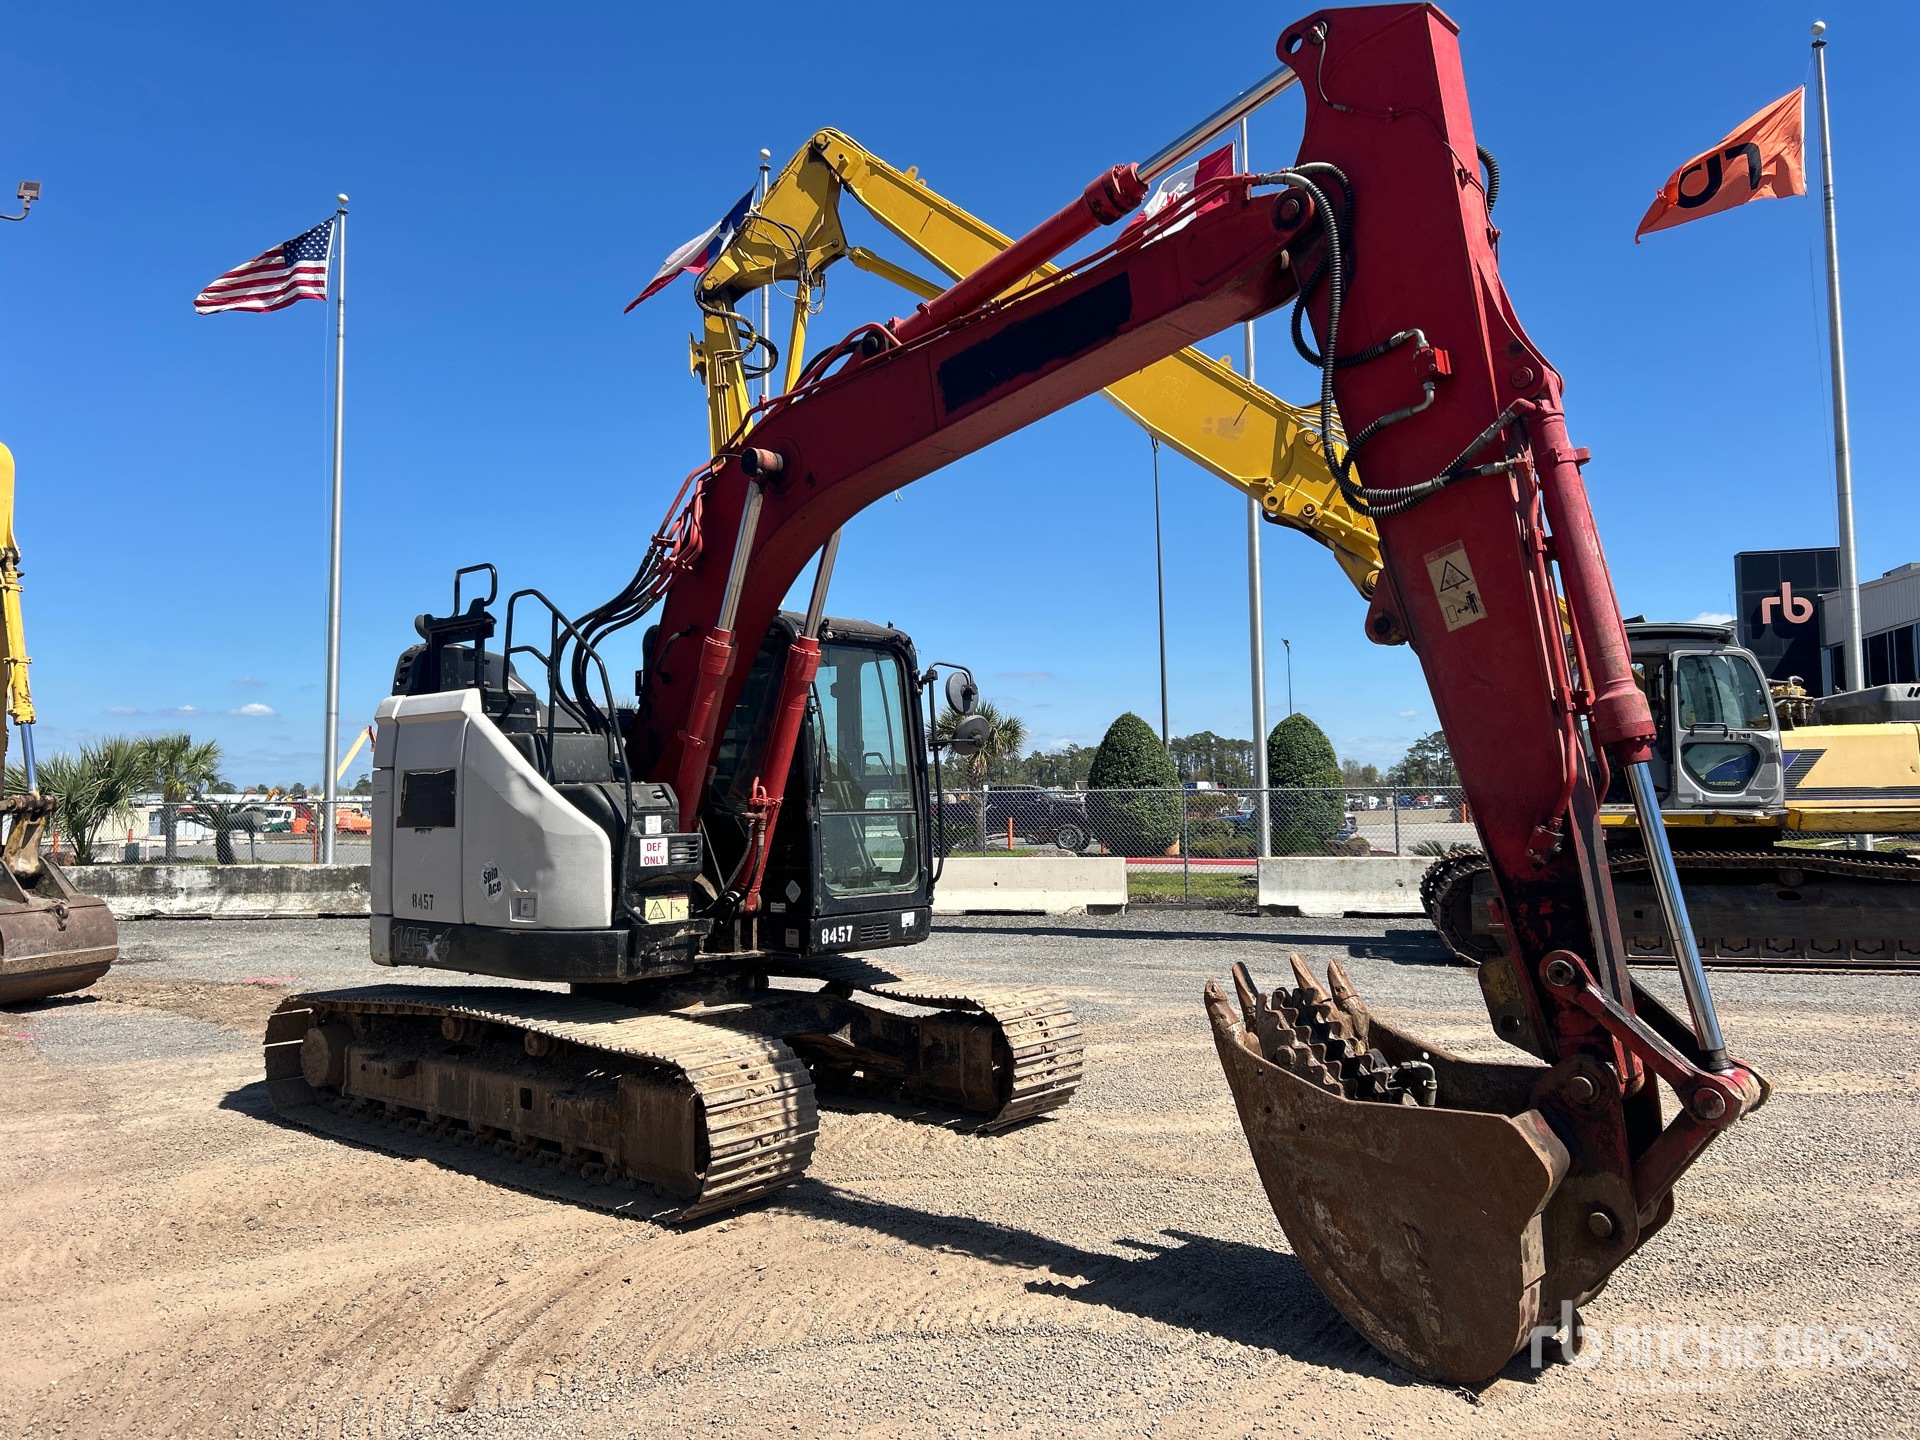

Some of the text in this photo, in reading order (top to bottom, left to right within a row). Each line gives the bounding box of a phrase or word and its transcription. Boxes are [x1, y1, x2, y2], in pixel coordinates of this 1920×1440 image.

[1761, 581, 1814, 625] rb
[646, 842, 662, 852] DEF
[643, 855, 665, 865] ONLY
[483, 867, 498, 884] Spin
[488, 881, 502, 896] Ace
[412, 893, 434, 910] 8457
[821, 925, 854, 945] 8457
